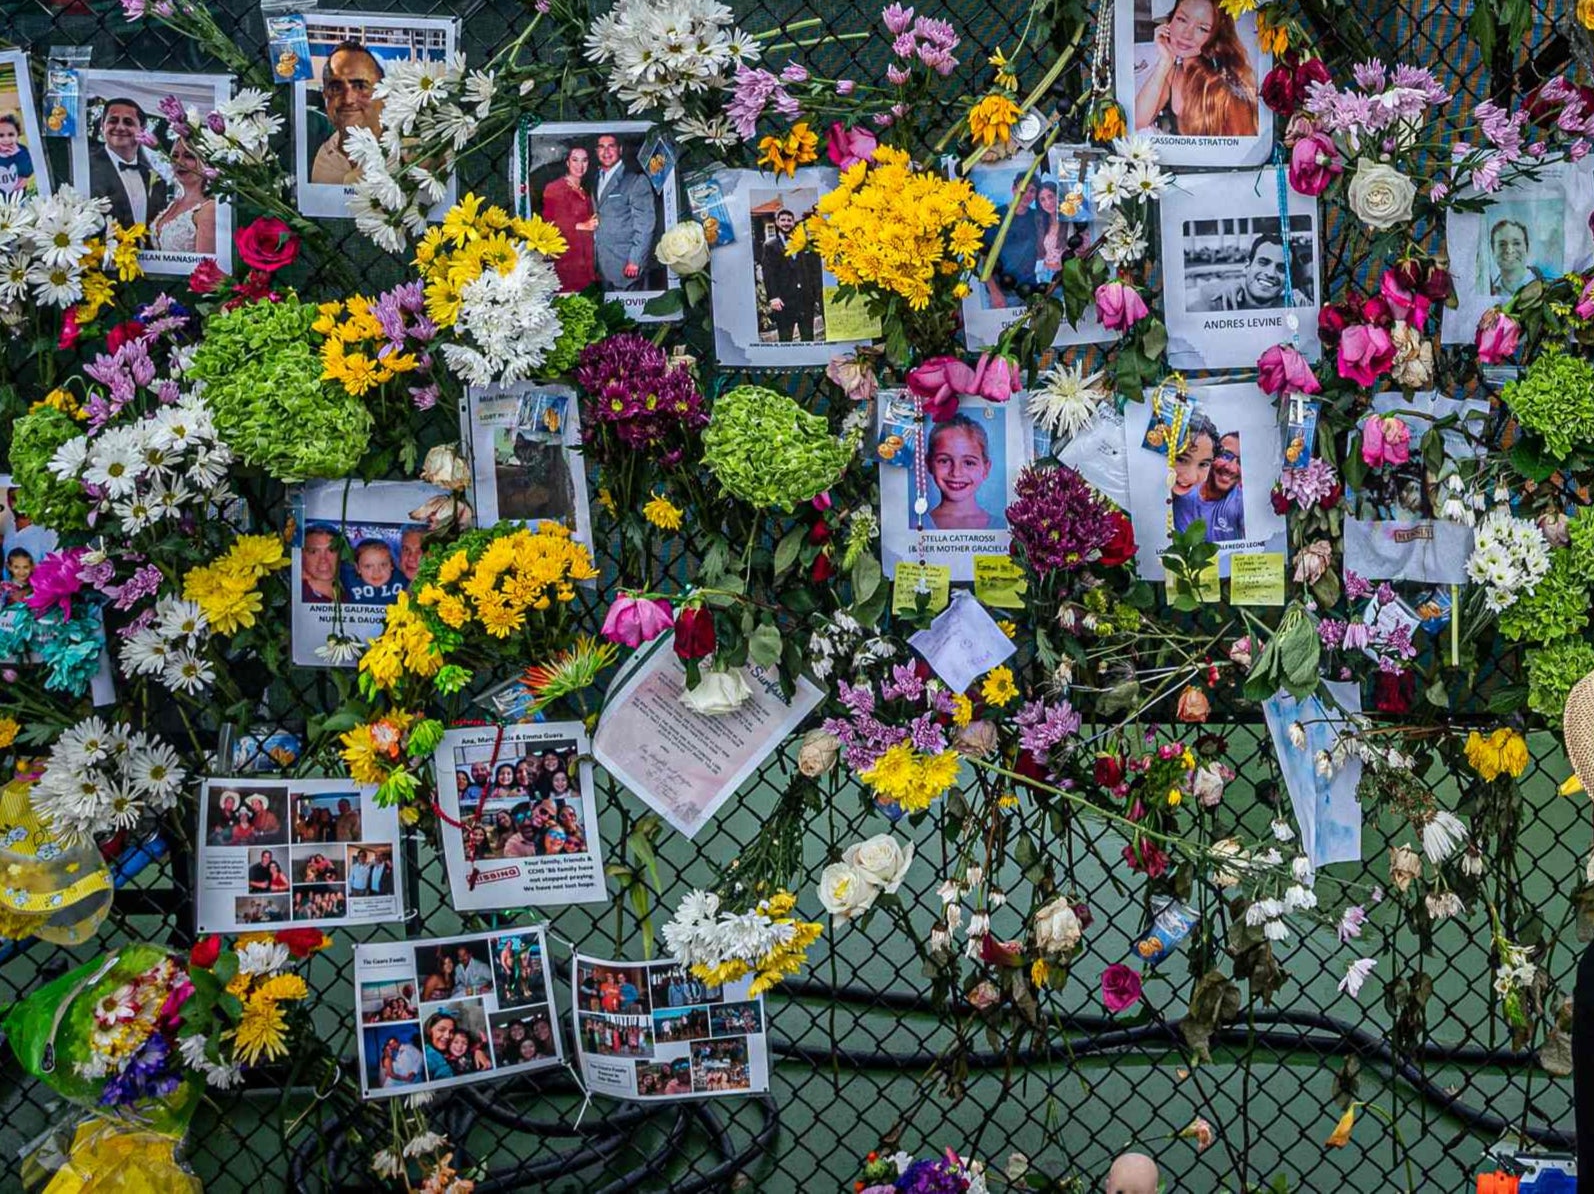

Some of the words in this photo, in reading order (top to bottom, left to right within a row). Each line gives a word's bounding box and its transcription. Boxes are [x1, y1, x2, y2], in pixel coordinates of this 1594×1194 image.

[1150, 137, 1197, 146] CASSONDRA
[1199, 138, 1239, 146] STRATTON
[1204, 319, 1245, 329] ANDRES
[1247, 317, 1282, 327] LEVINE
[921, 535, 948, 543] STELLA
[949, 535, 995, 543] CATTAROSSI
[936, 545, 970, 553] MOTHER
[972, 545, 1008, 553] GRACIELA
[467, 869, 517, 884] ISSING
